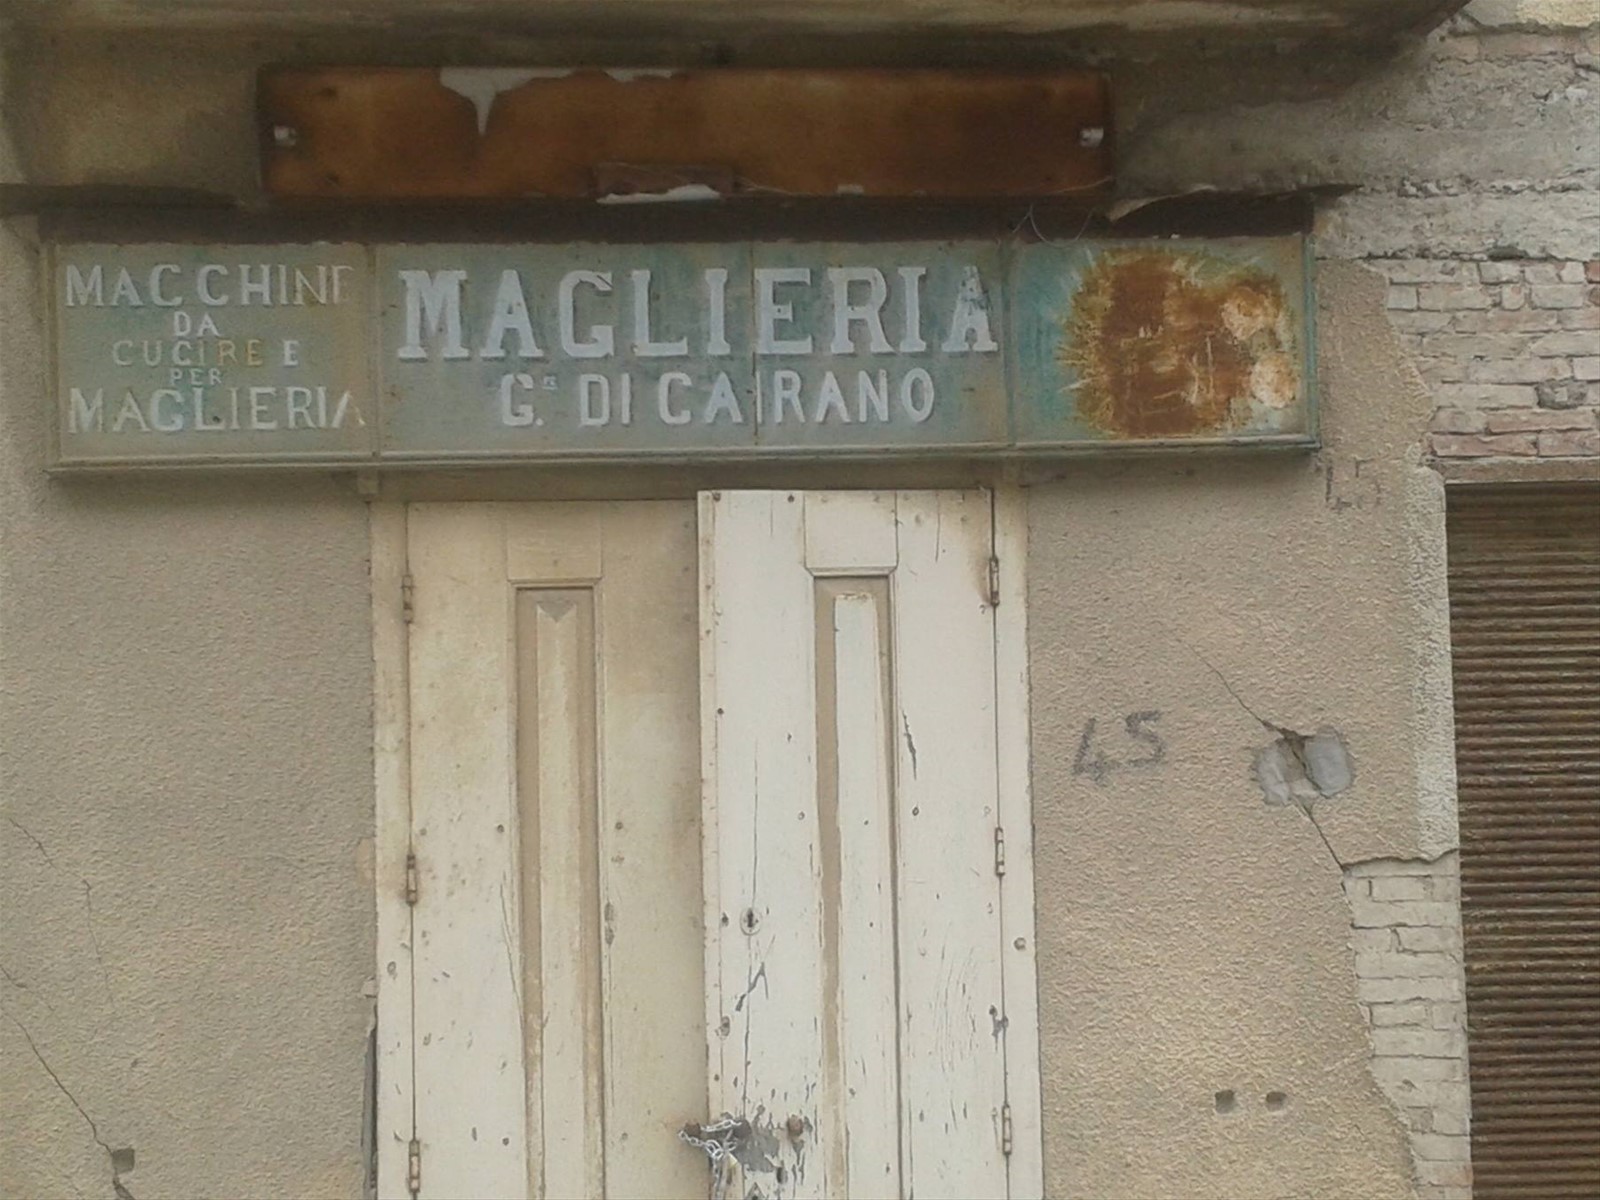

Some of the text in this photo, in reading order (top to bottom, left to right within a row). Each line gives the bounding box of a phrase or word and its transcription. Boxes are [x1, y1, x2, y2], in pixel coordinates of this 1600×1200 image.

[172, 311, 222, 338] DA
[397, 266, 999, 361] MAGLIERIA
[111, 339, 300, 367] CUCIRE E
[169, 367, 223, 386] PER
[67, 386, 366, 433] MAGLIERIA
[658, 367, 935, 425] CAIRANO
[1072, 711, 1165, 786] 45
